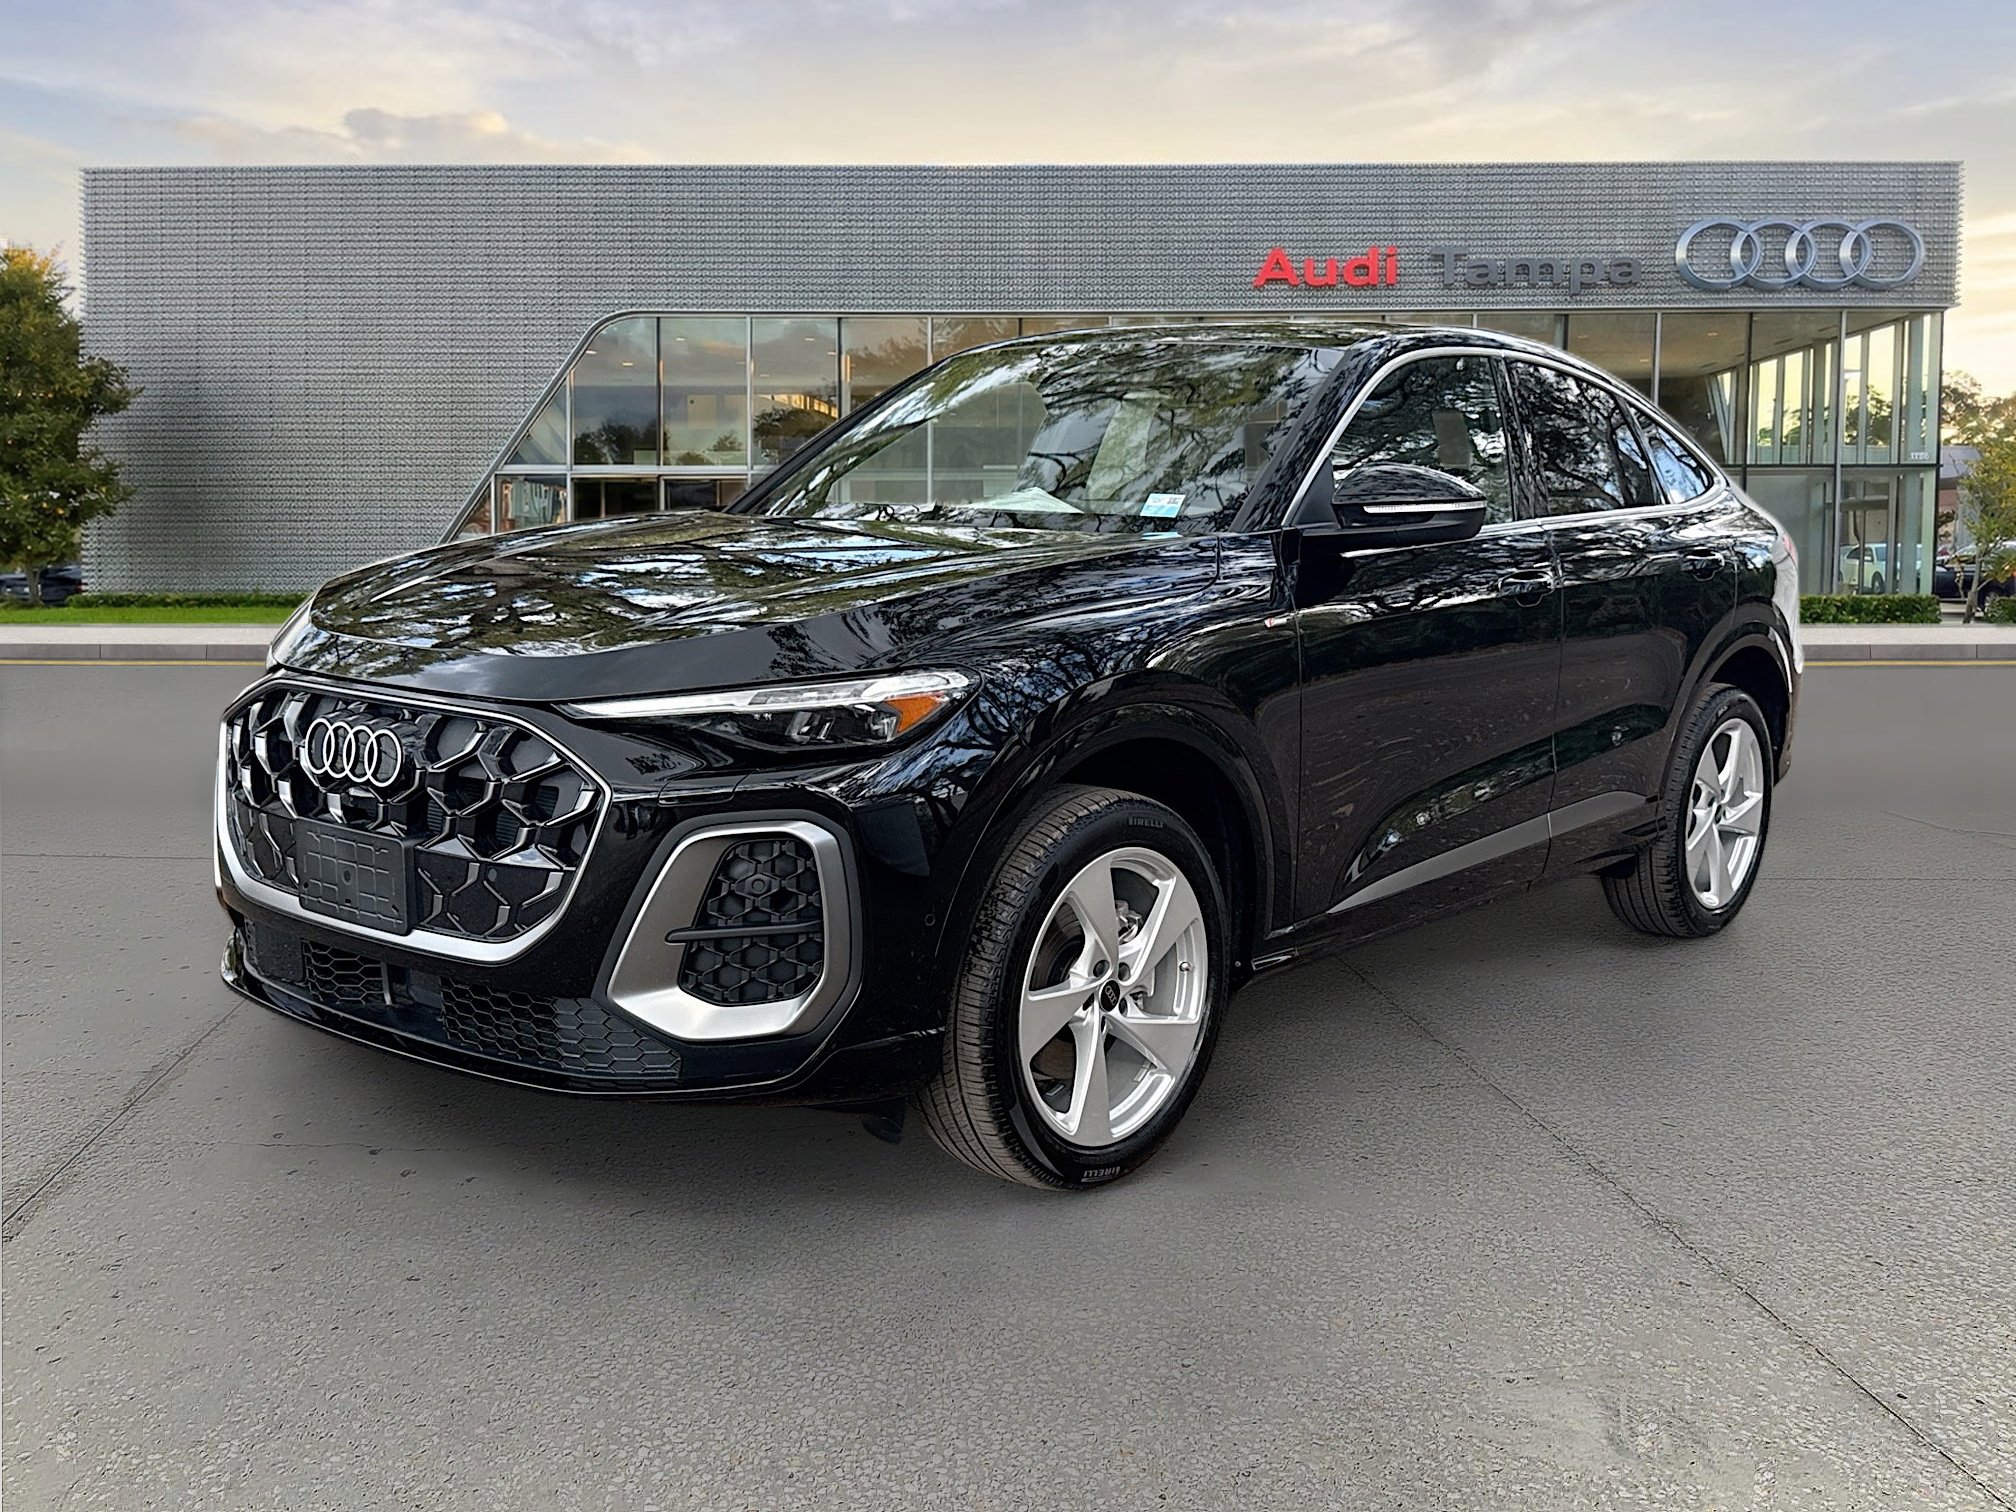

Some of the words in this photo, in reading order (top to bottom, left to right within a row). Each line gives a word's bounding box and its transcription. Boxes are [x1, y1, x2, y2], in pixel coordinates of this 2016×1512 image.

[1252, 246, 1397, 287] Audi
[1430, 245, 1642, 297] Tampa
[1081, 1165, 1121, 1182] PIRELLI
